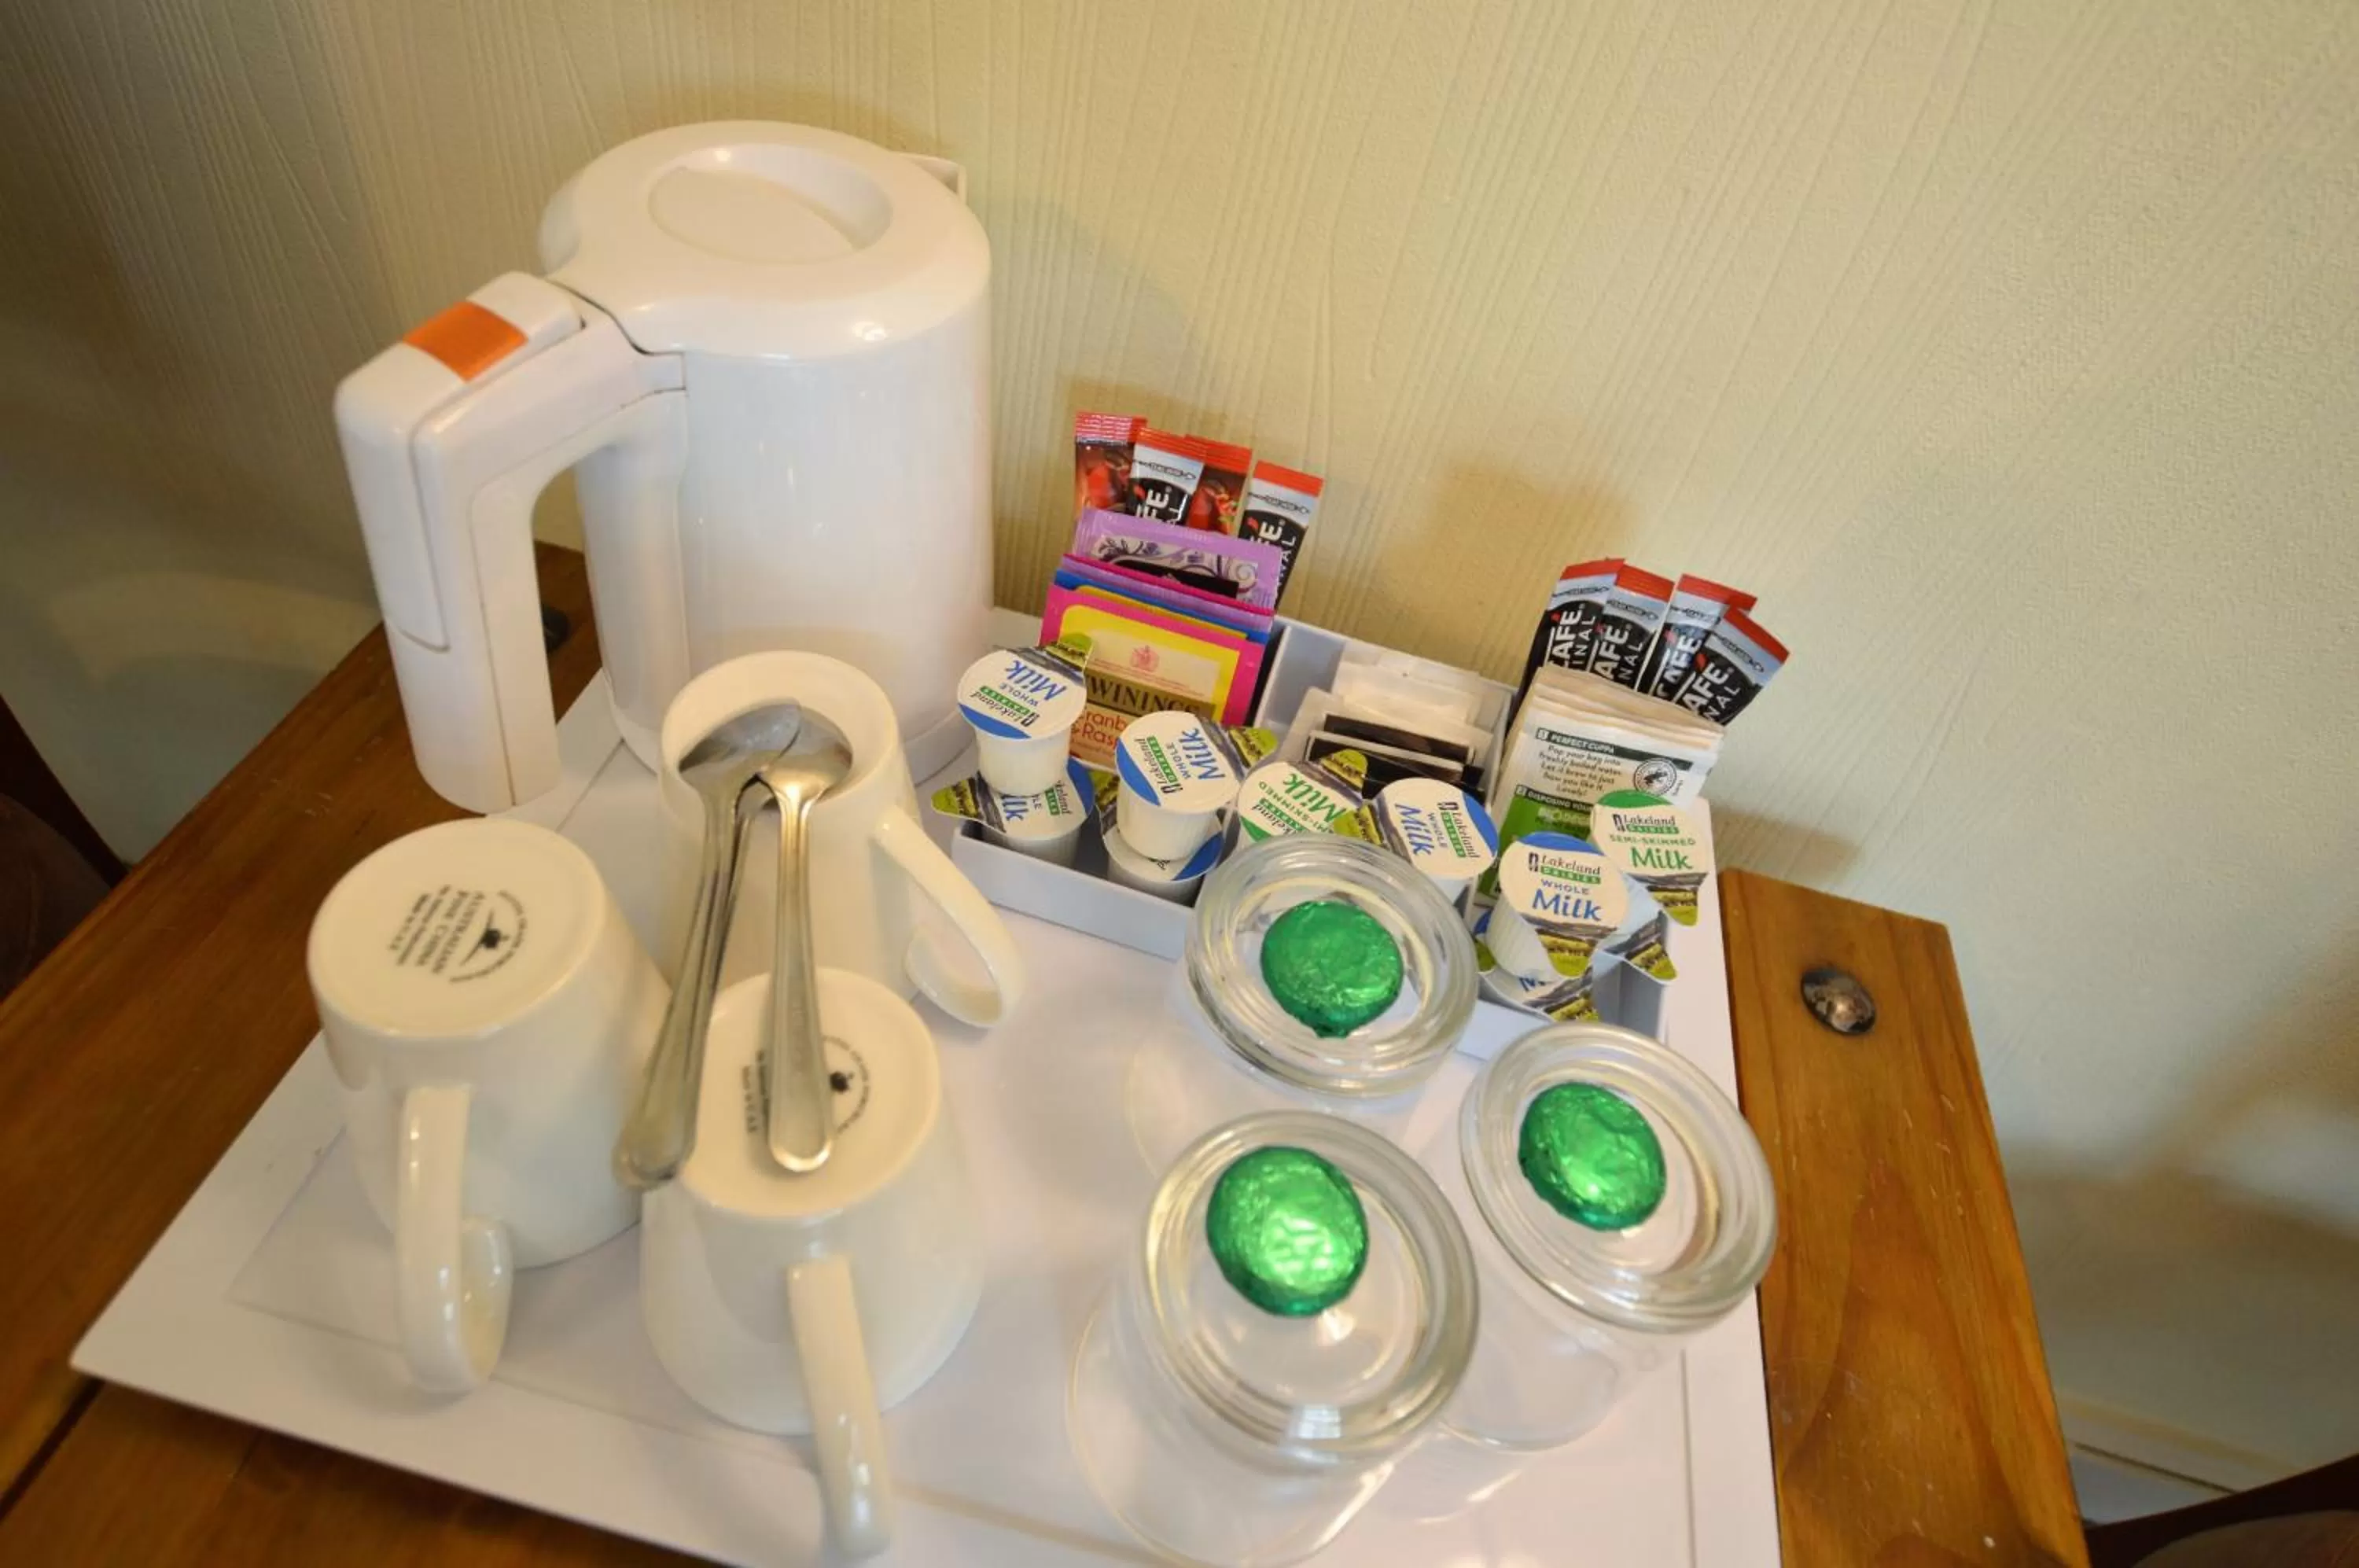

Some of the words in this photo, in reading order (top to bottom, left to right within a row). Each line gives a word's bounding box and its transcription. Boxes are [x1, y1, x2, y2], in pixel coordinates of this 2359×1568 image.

[1618, 642, 1643, 680] NAL
[999, 683, 1039, 707] WHOLE
[1005, 660, 1067, 701] Milk
[970, 692, 1021, 721] Lakeland
[1703, 686, 1741, 721] NAL
[1134, 738, 1168, 786] Lakeland
[1166, 742, 1191, 780] WHOLE
[1179, 727, 1226, 780] Milk
[1283, 773, 1347, 823] Milk
[1395, 802, 1435, 856] Milk
[1426, 812, 1448, 848] WHOLE
[1452, 812, 1480, 859] Lakeland
[1625, 814, 1676, 827] Lakeland
[1610, 835, 1696, 846] SEMI-SKIMMED
[1540, 851, 1601, 876] Lakeland
[1630, 847, 1693, 870] Milk
[1541, 879, 1590, 895] WHOLE
[1532, 888, 1603, 922] Milk
